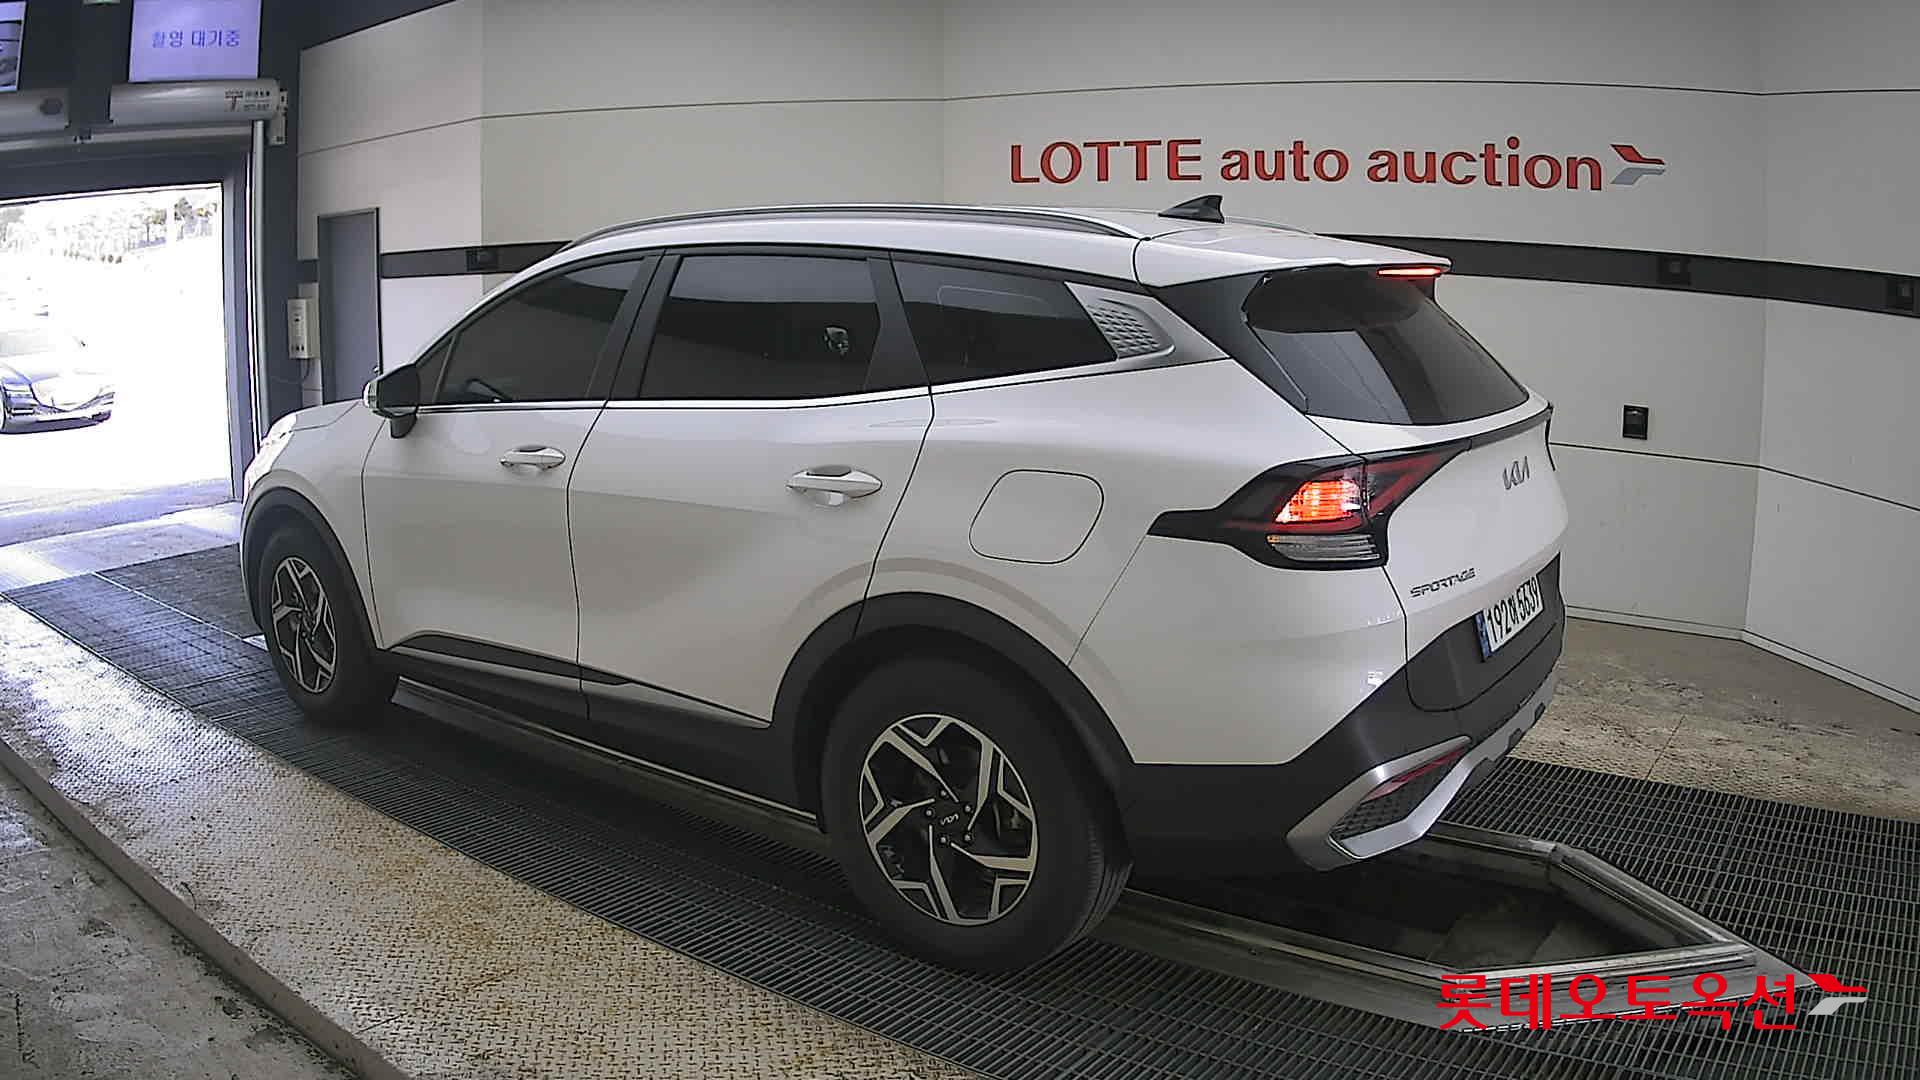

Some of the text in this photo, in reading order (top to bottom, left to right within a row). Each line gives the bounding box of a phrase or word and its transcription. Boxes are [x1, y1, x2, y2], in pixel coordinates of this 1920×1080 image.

[191, 30, 240, 48] 대기중
[1010, 136, 1602, 191] LOTTE auto auction
[1409, 567, 1476, 598] SPORTAGE
